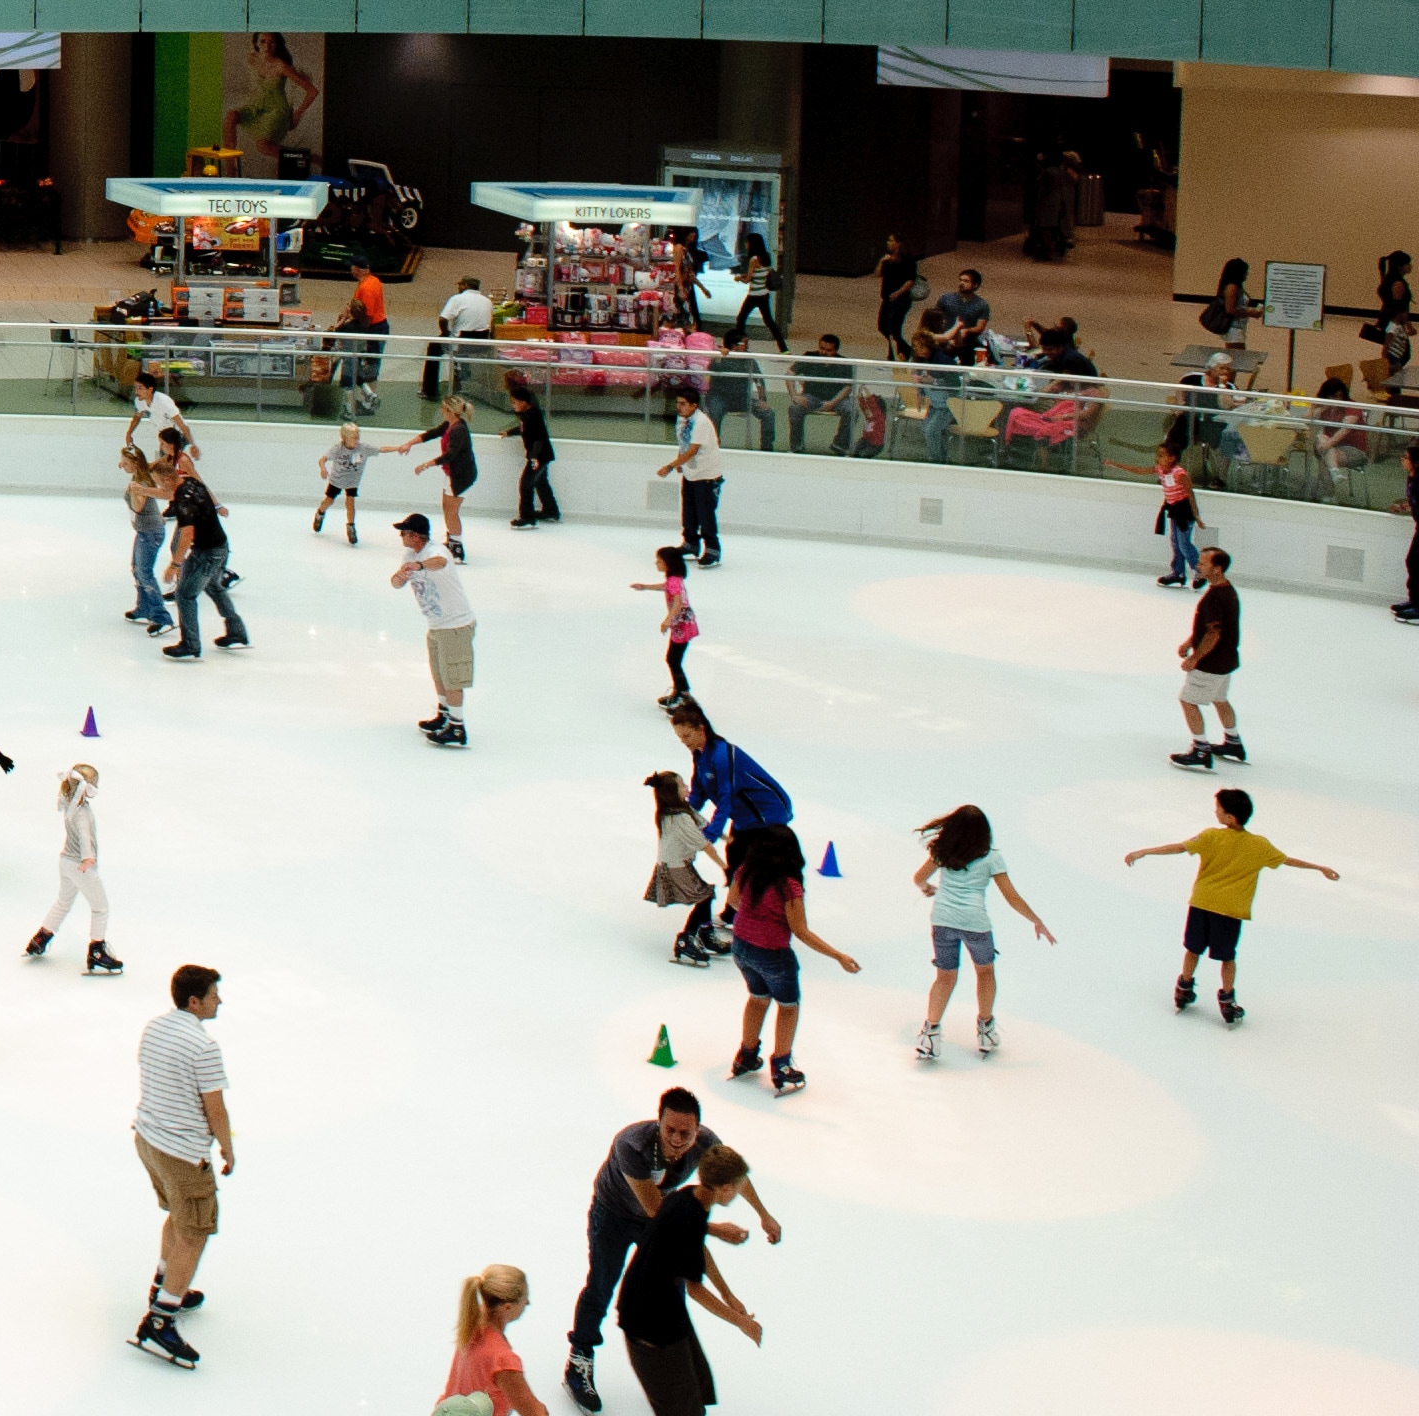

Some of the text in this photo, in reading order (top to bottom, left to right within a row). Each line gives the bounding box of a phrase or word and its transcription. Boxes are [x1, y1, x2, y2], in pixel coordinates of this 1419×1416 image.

[208, 199, 268, 214] TEC TOYS
[575, 206, 652, 219] KITTY LOVERS
